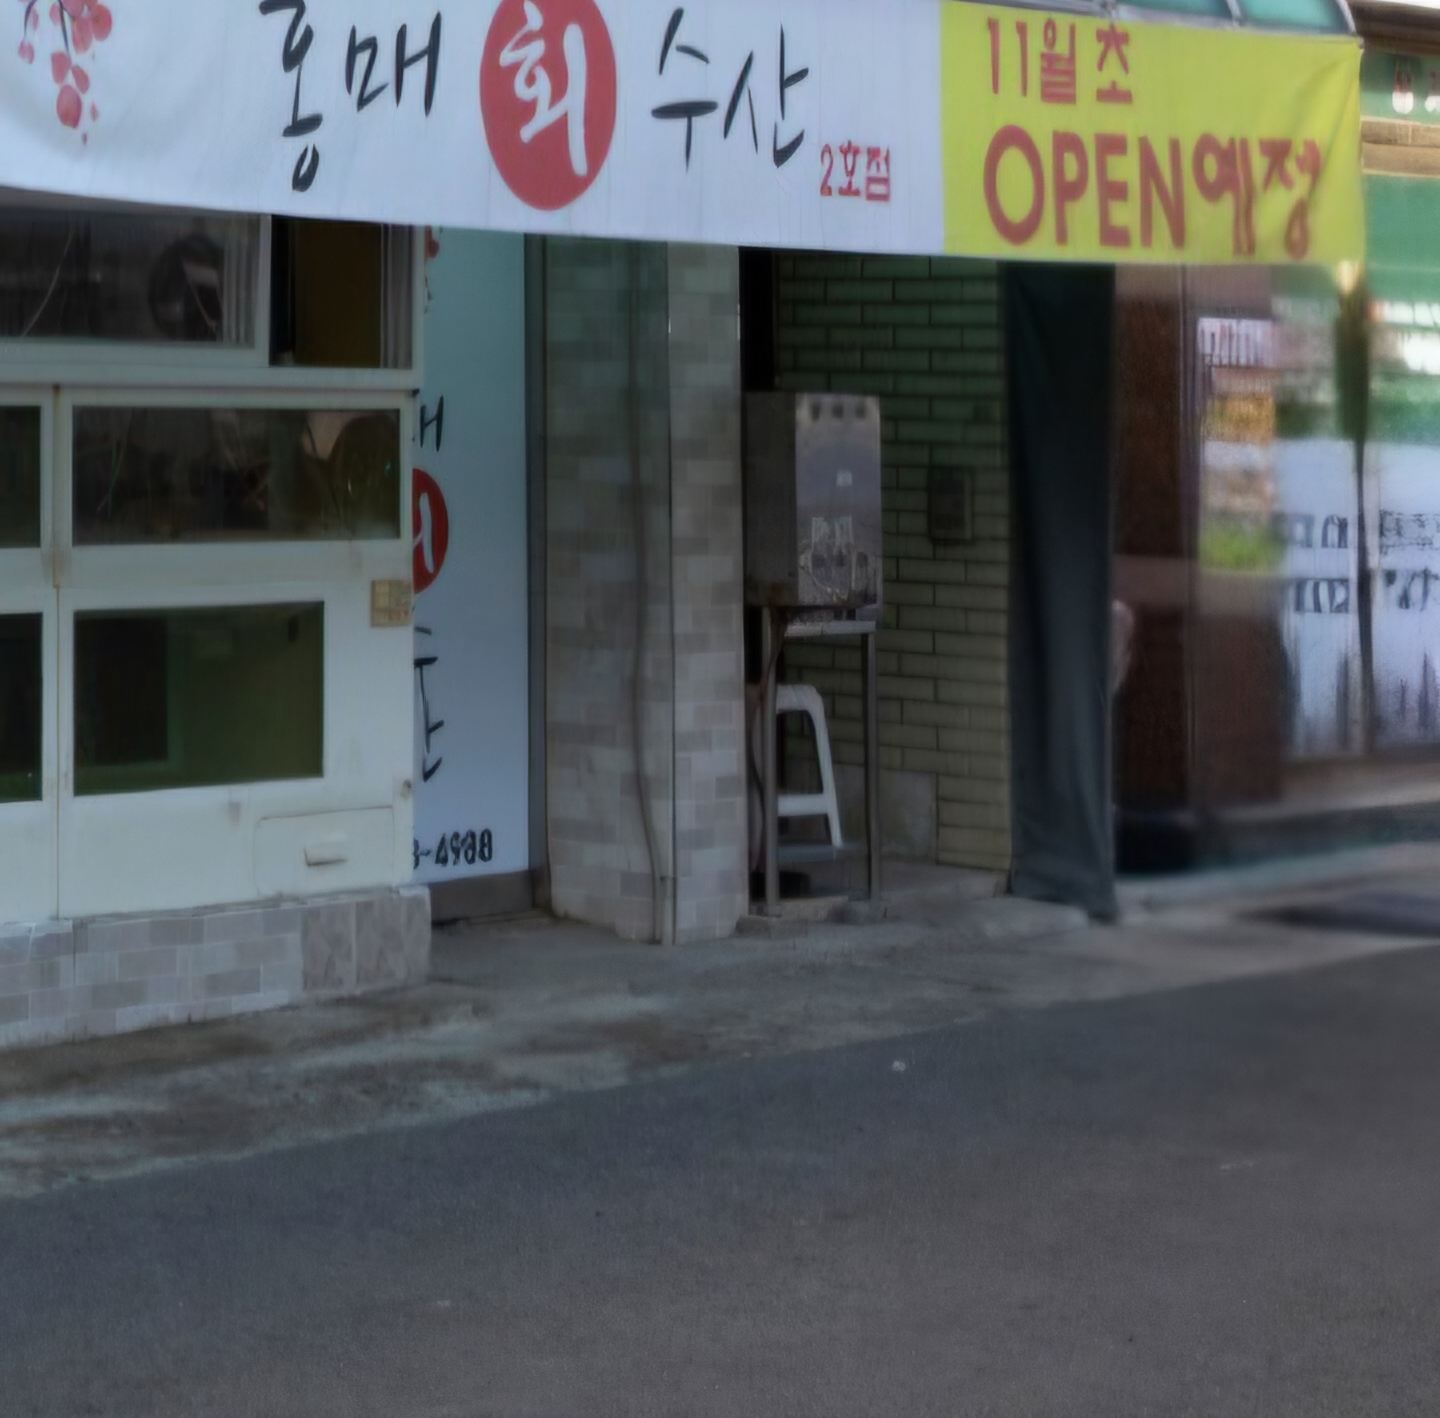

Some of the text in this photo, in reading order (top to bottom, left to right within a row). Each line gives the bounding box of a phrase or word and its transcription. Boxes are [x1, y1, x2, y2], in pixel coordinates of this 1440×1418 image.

[650, 5, 810, 170] 수산
[819, 138, 894, 204] 2호점
[982, 16, 1135, 108] 11월 초
[982, 122, 1323, 262] OPEN예정
